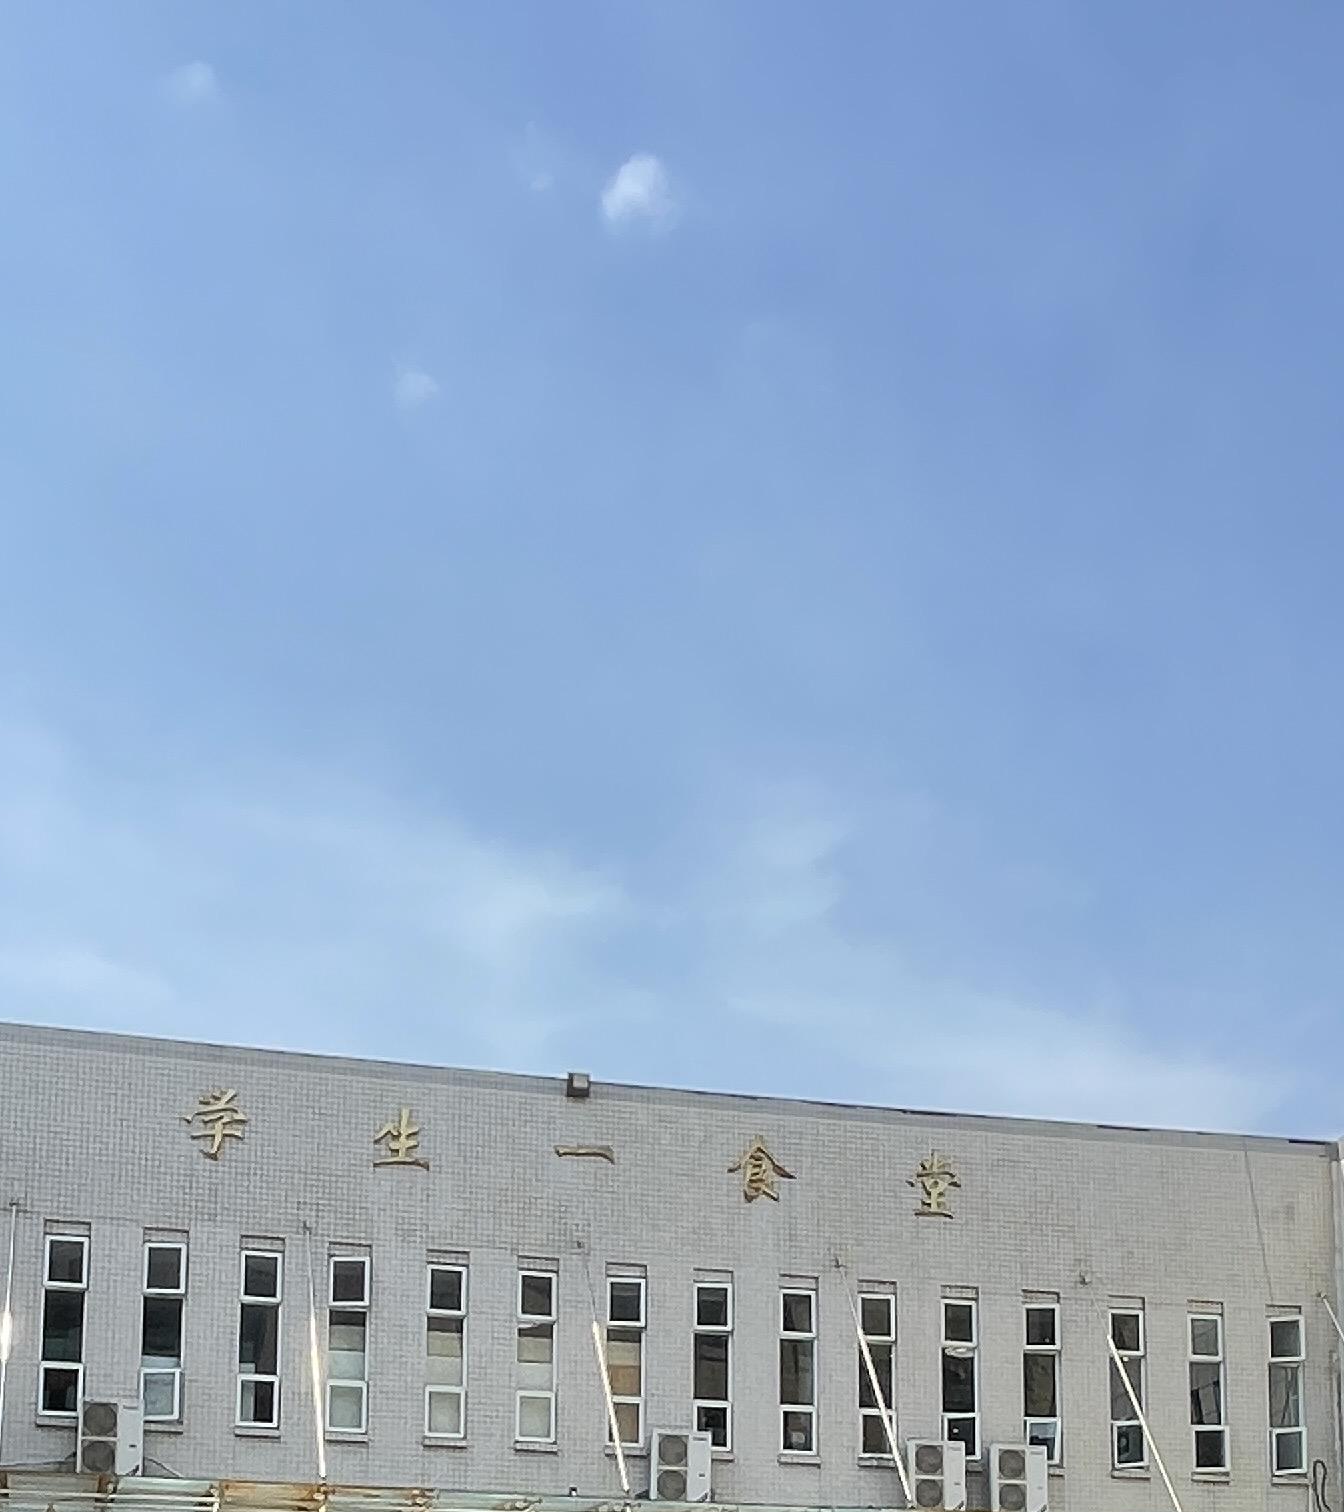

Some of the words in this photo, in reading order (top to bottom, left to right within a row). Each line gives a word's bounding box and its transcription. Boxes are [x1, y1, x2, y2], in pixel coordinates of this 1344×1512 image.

[183, 1087, 962, 1219] 学生一食堂
